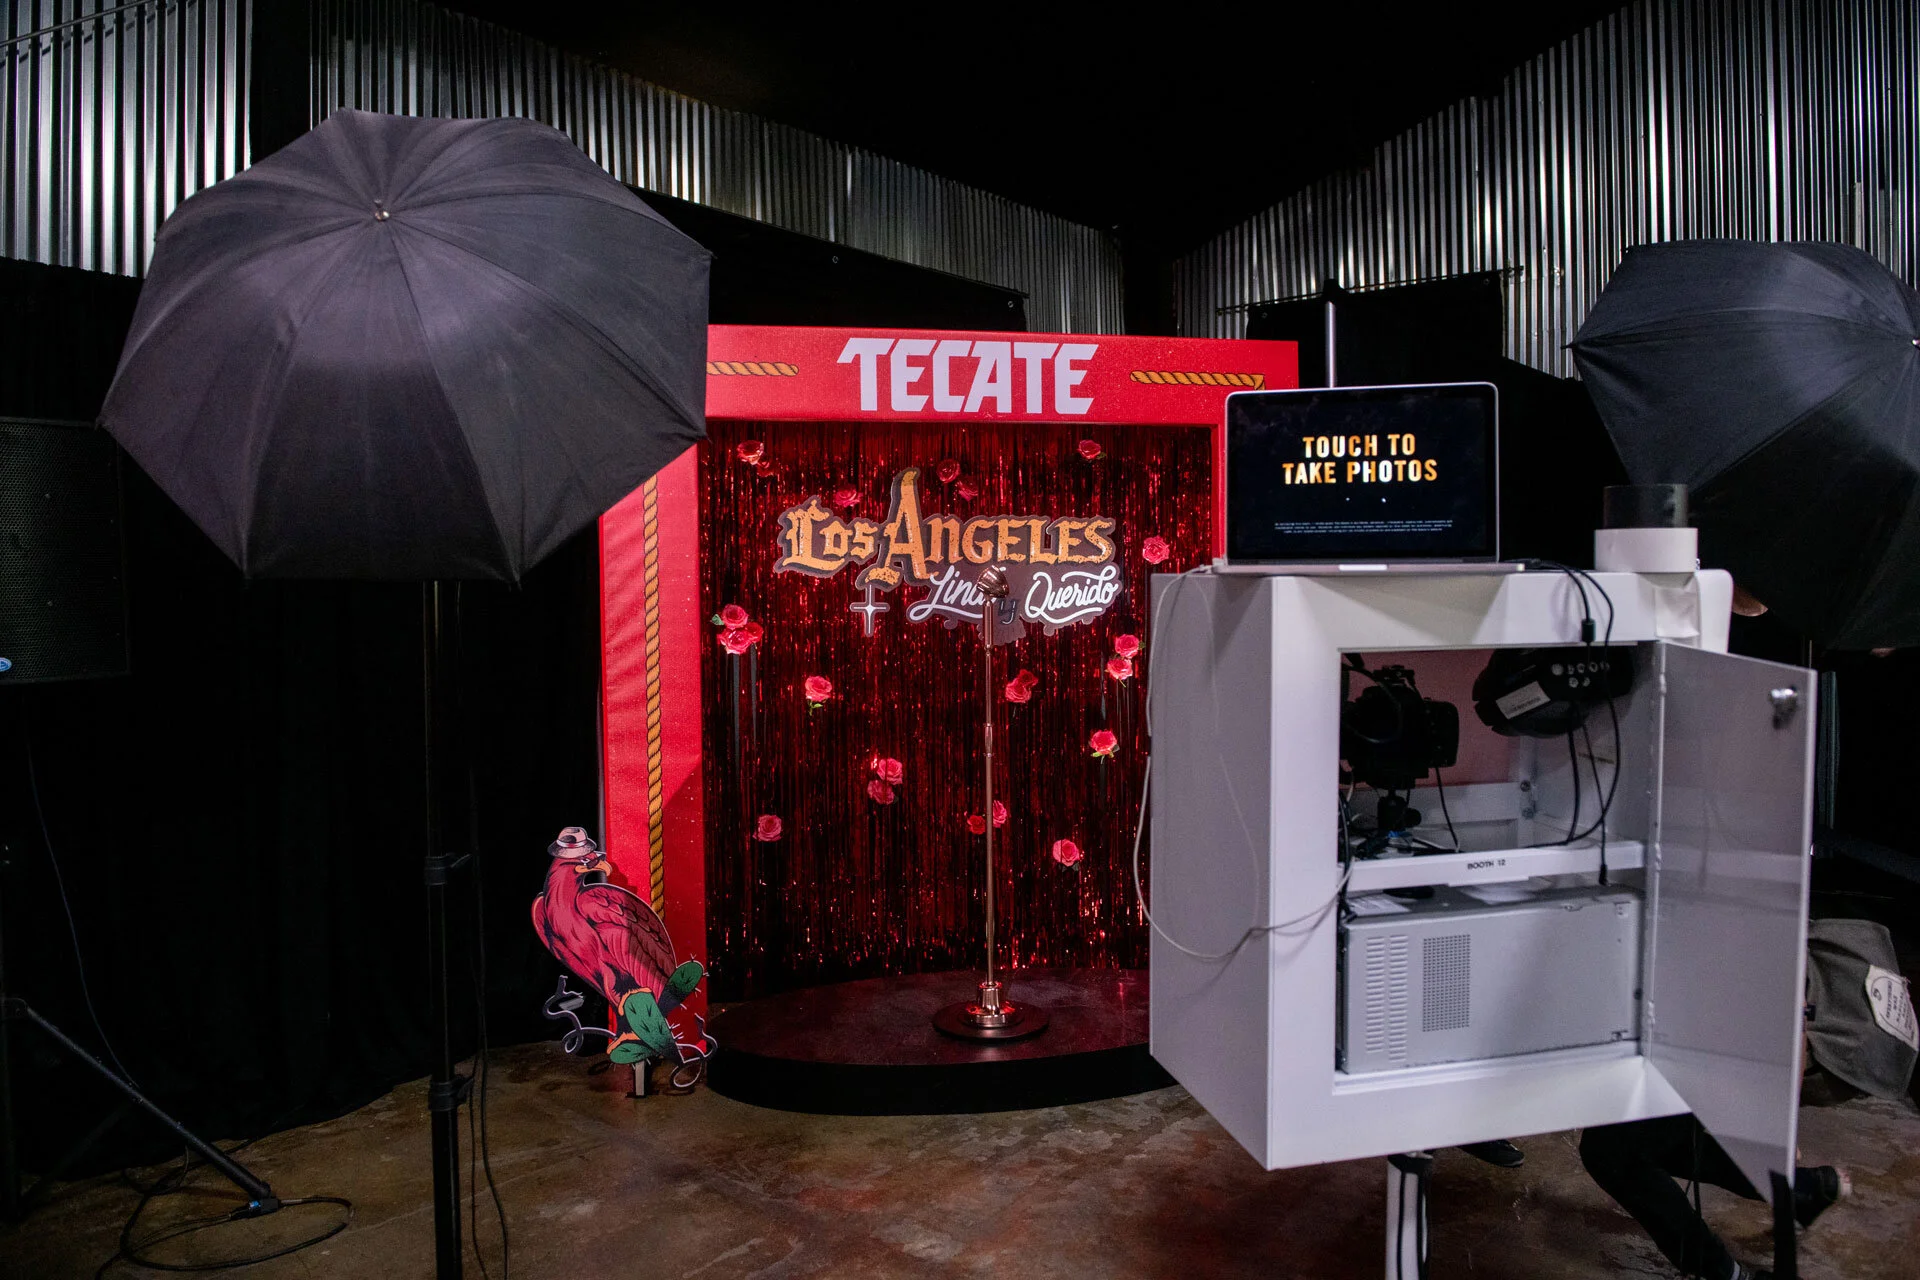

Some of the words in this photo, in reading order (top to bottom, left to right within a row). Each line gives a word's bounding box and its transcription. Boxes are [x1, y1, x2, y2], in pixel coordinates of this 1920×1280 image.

[837, 337, 1100, 415] TECATE
[1302, 435, 1378, 458] TOUCH
[1387, 433, 1416, 456] TO
[1282, 462, 1337, 485] TAKE
[1346, 459, 1438, 483] PHOTOS
[1024, 565, 1119, 624] Querido
[1467, 860, 1494, 870] BOOTH
